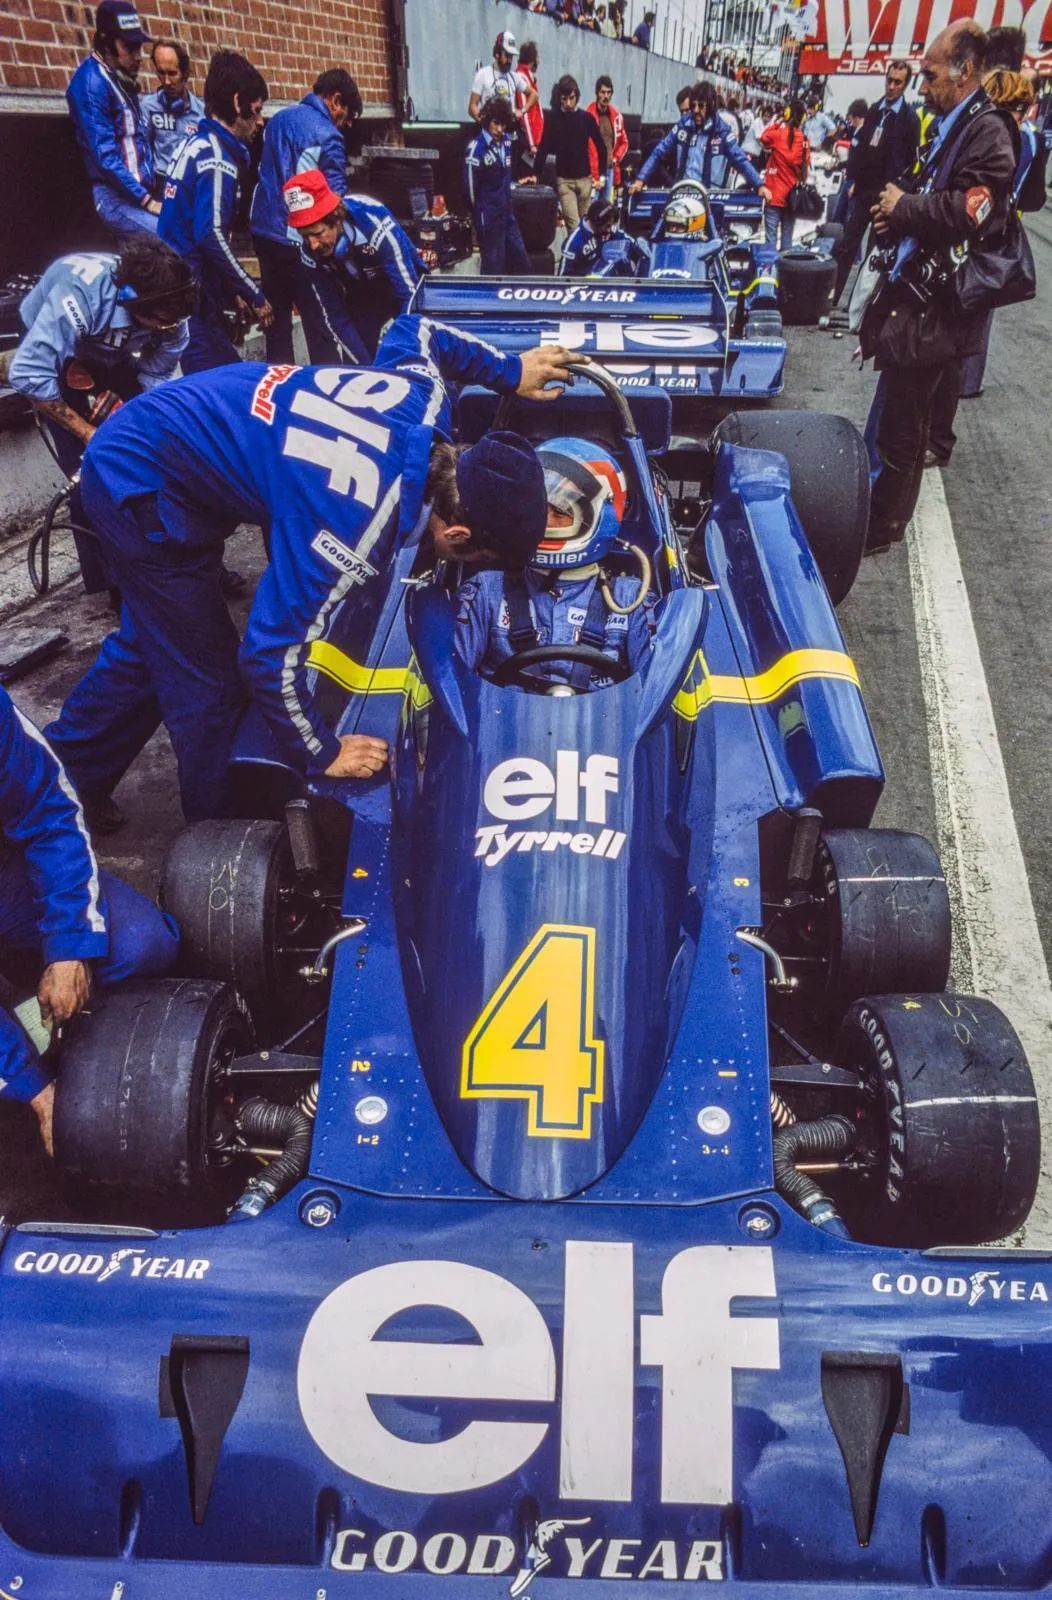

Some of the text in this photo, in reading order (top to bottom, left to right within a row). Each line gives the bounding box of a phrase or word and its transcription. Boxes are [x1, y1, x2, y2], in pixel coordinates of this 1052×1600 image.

[152, 113, 176, 130] elf
[283, 367, 412, 510] elf
[483, 750, 619, 825] elf
[474, 824, 627, 868] Tyrrell
[460, 923, 605, 1140] 4
[297, 1240, 780, 1505] elf
